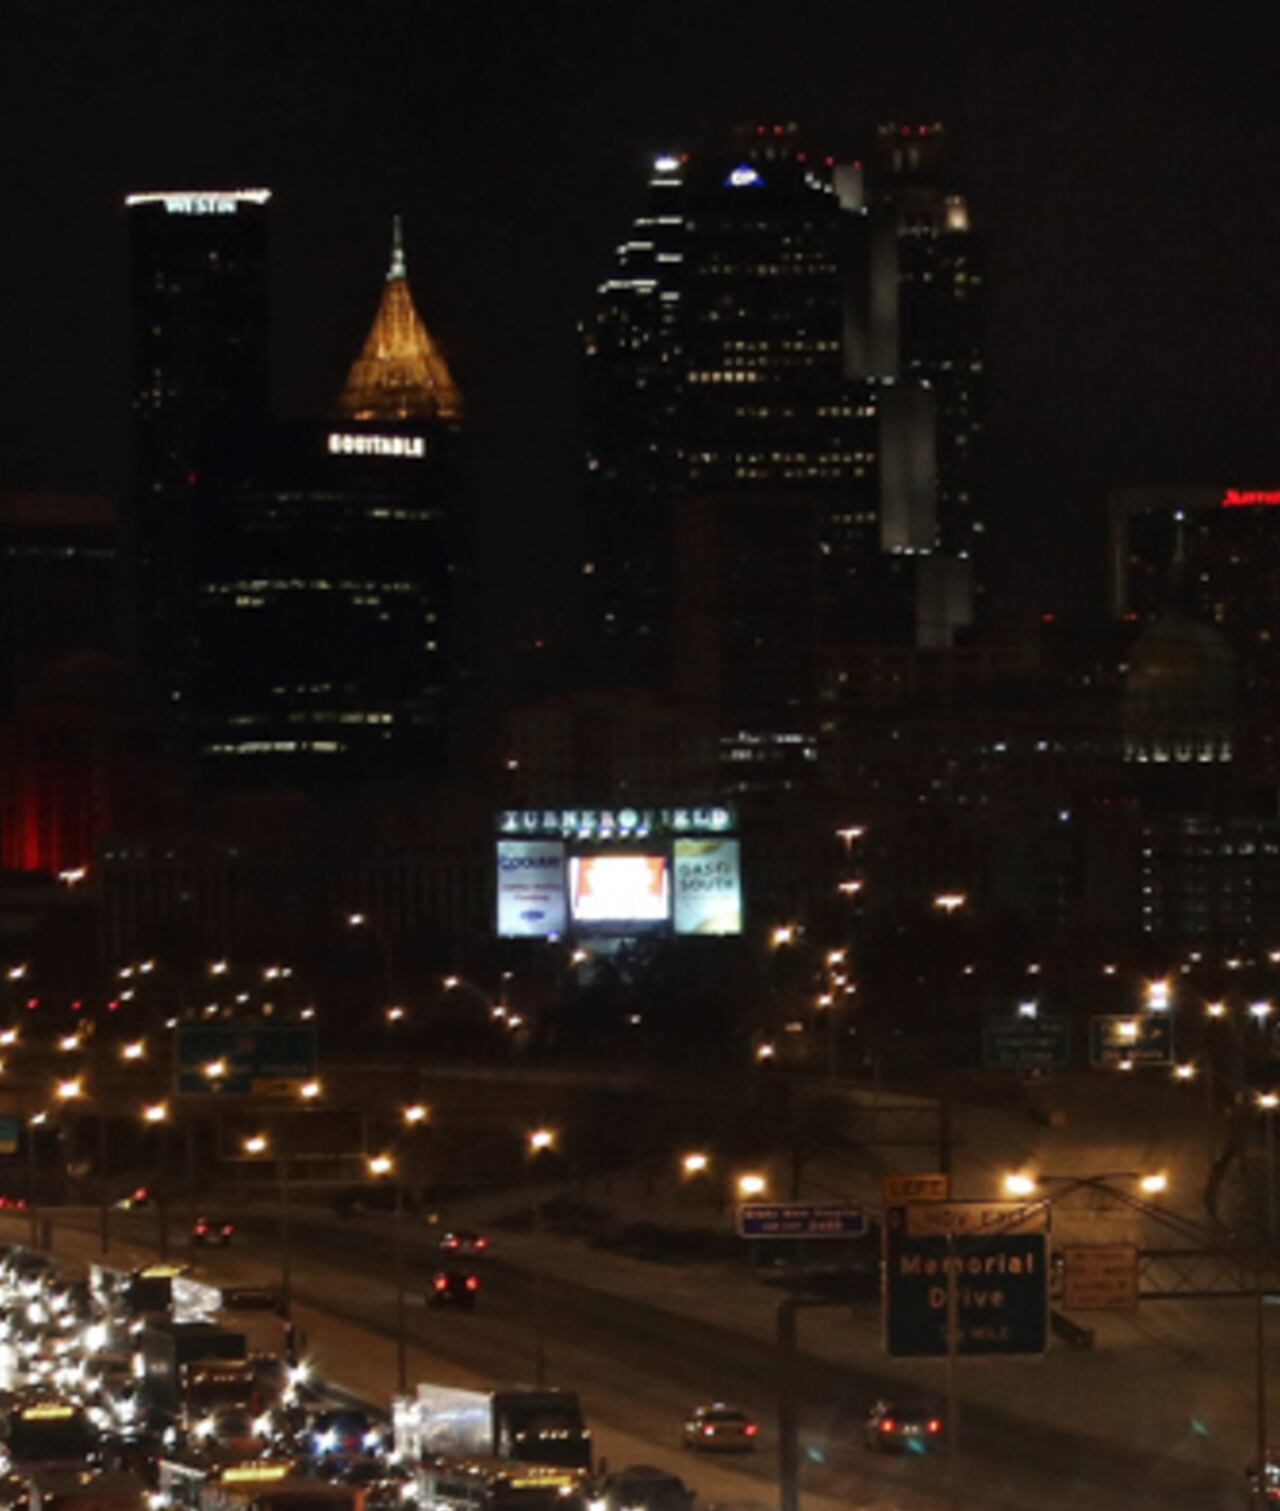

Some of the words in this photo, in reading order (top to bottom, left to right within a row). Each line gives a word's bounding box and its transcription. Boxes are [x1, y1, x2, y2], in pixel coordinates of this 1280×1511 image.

[499, 809, 616, 834] TURNER
[900, 1254, 1035, 1274] Memorial
[930, 1287, 1004, 1308] Dive
